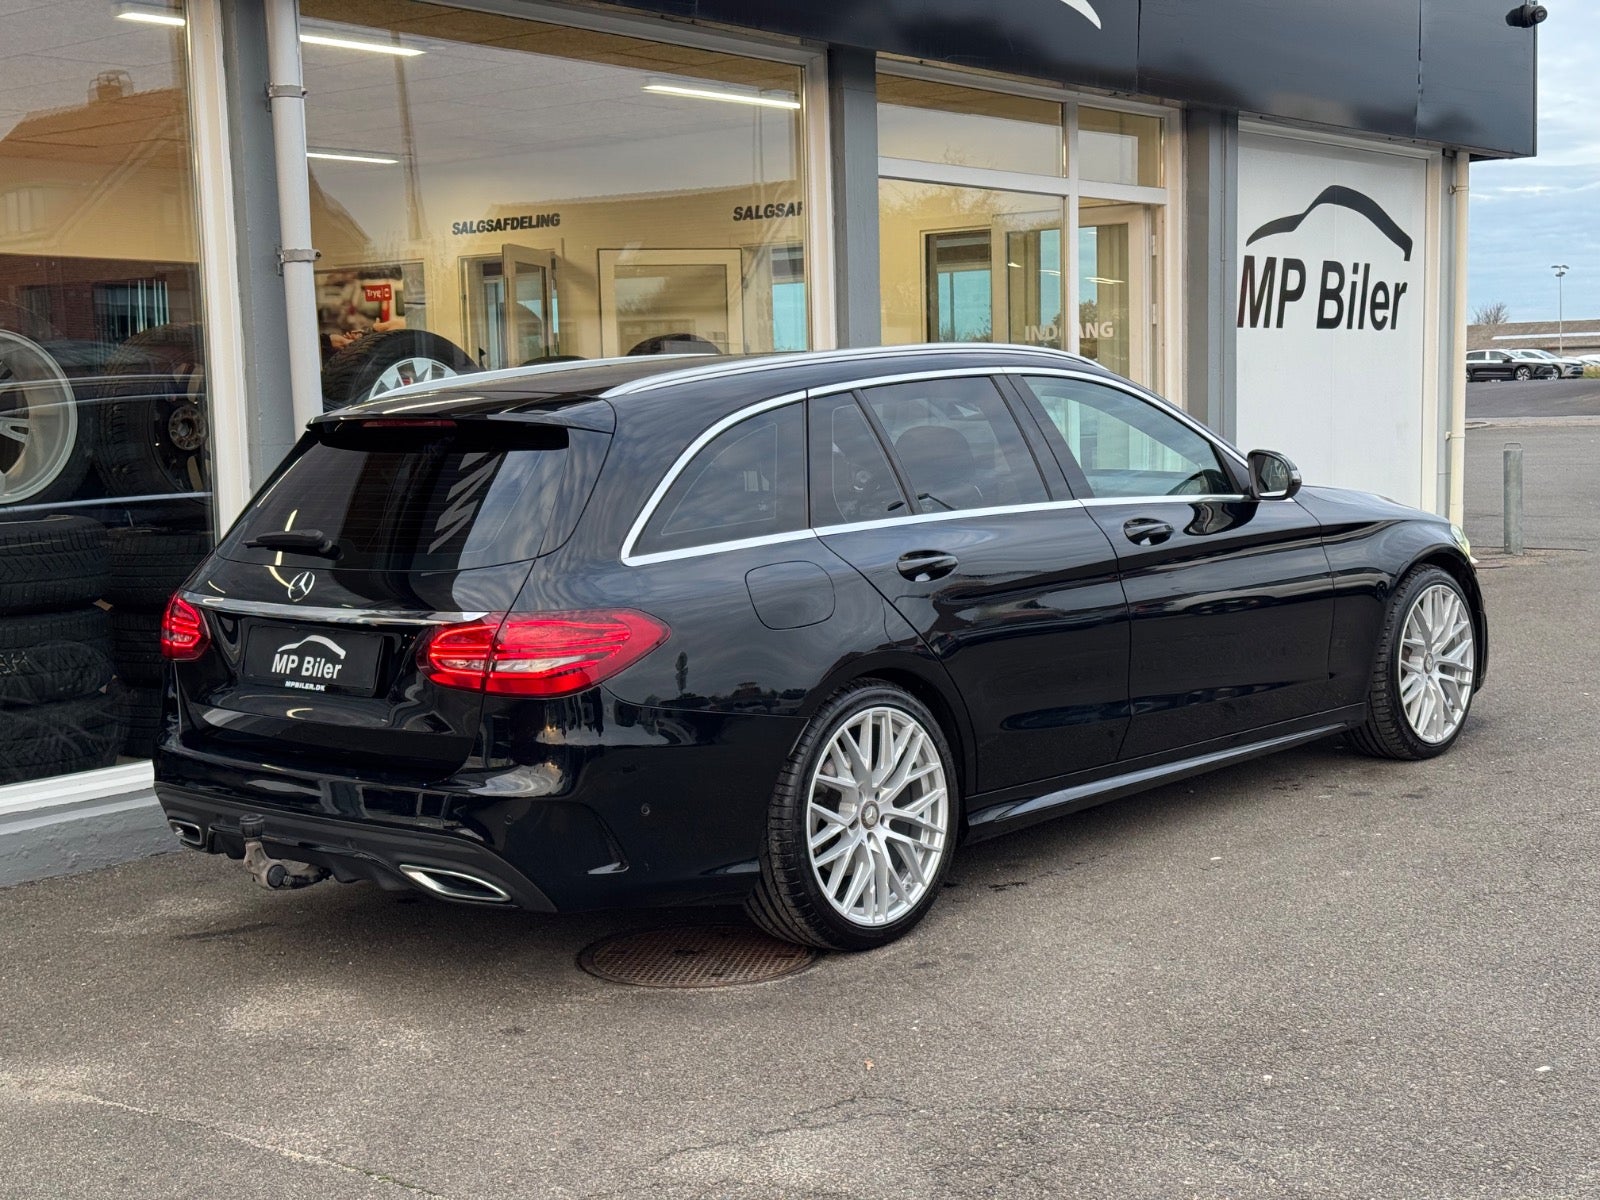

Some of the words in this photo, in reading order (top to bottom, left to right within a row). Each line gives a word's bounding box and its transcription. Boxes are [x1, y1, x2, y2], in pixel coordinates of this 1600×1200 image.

[452, 213, 560, 235] SALGSAFDELING
[366, 289, 382, 299] Tryg
[1237, 255, 1306, 329] MP
[1316, 260, 1408, 331] Biler
[271, 653, 299, 675] MP
[301, 656, 342, 679] Biler
[285, 680, 326, 691] MPBILER.DK
